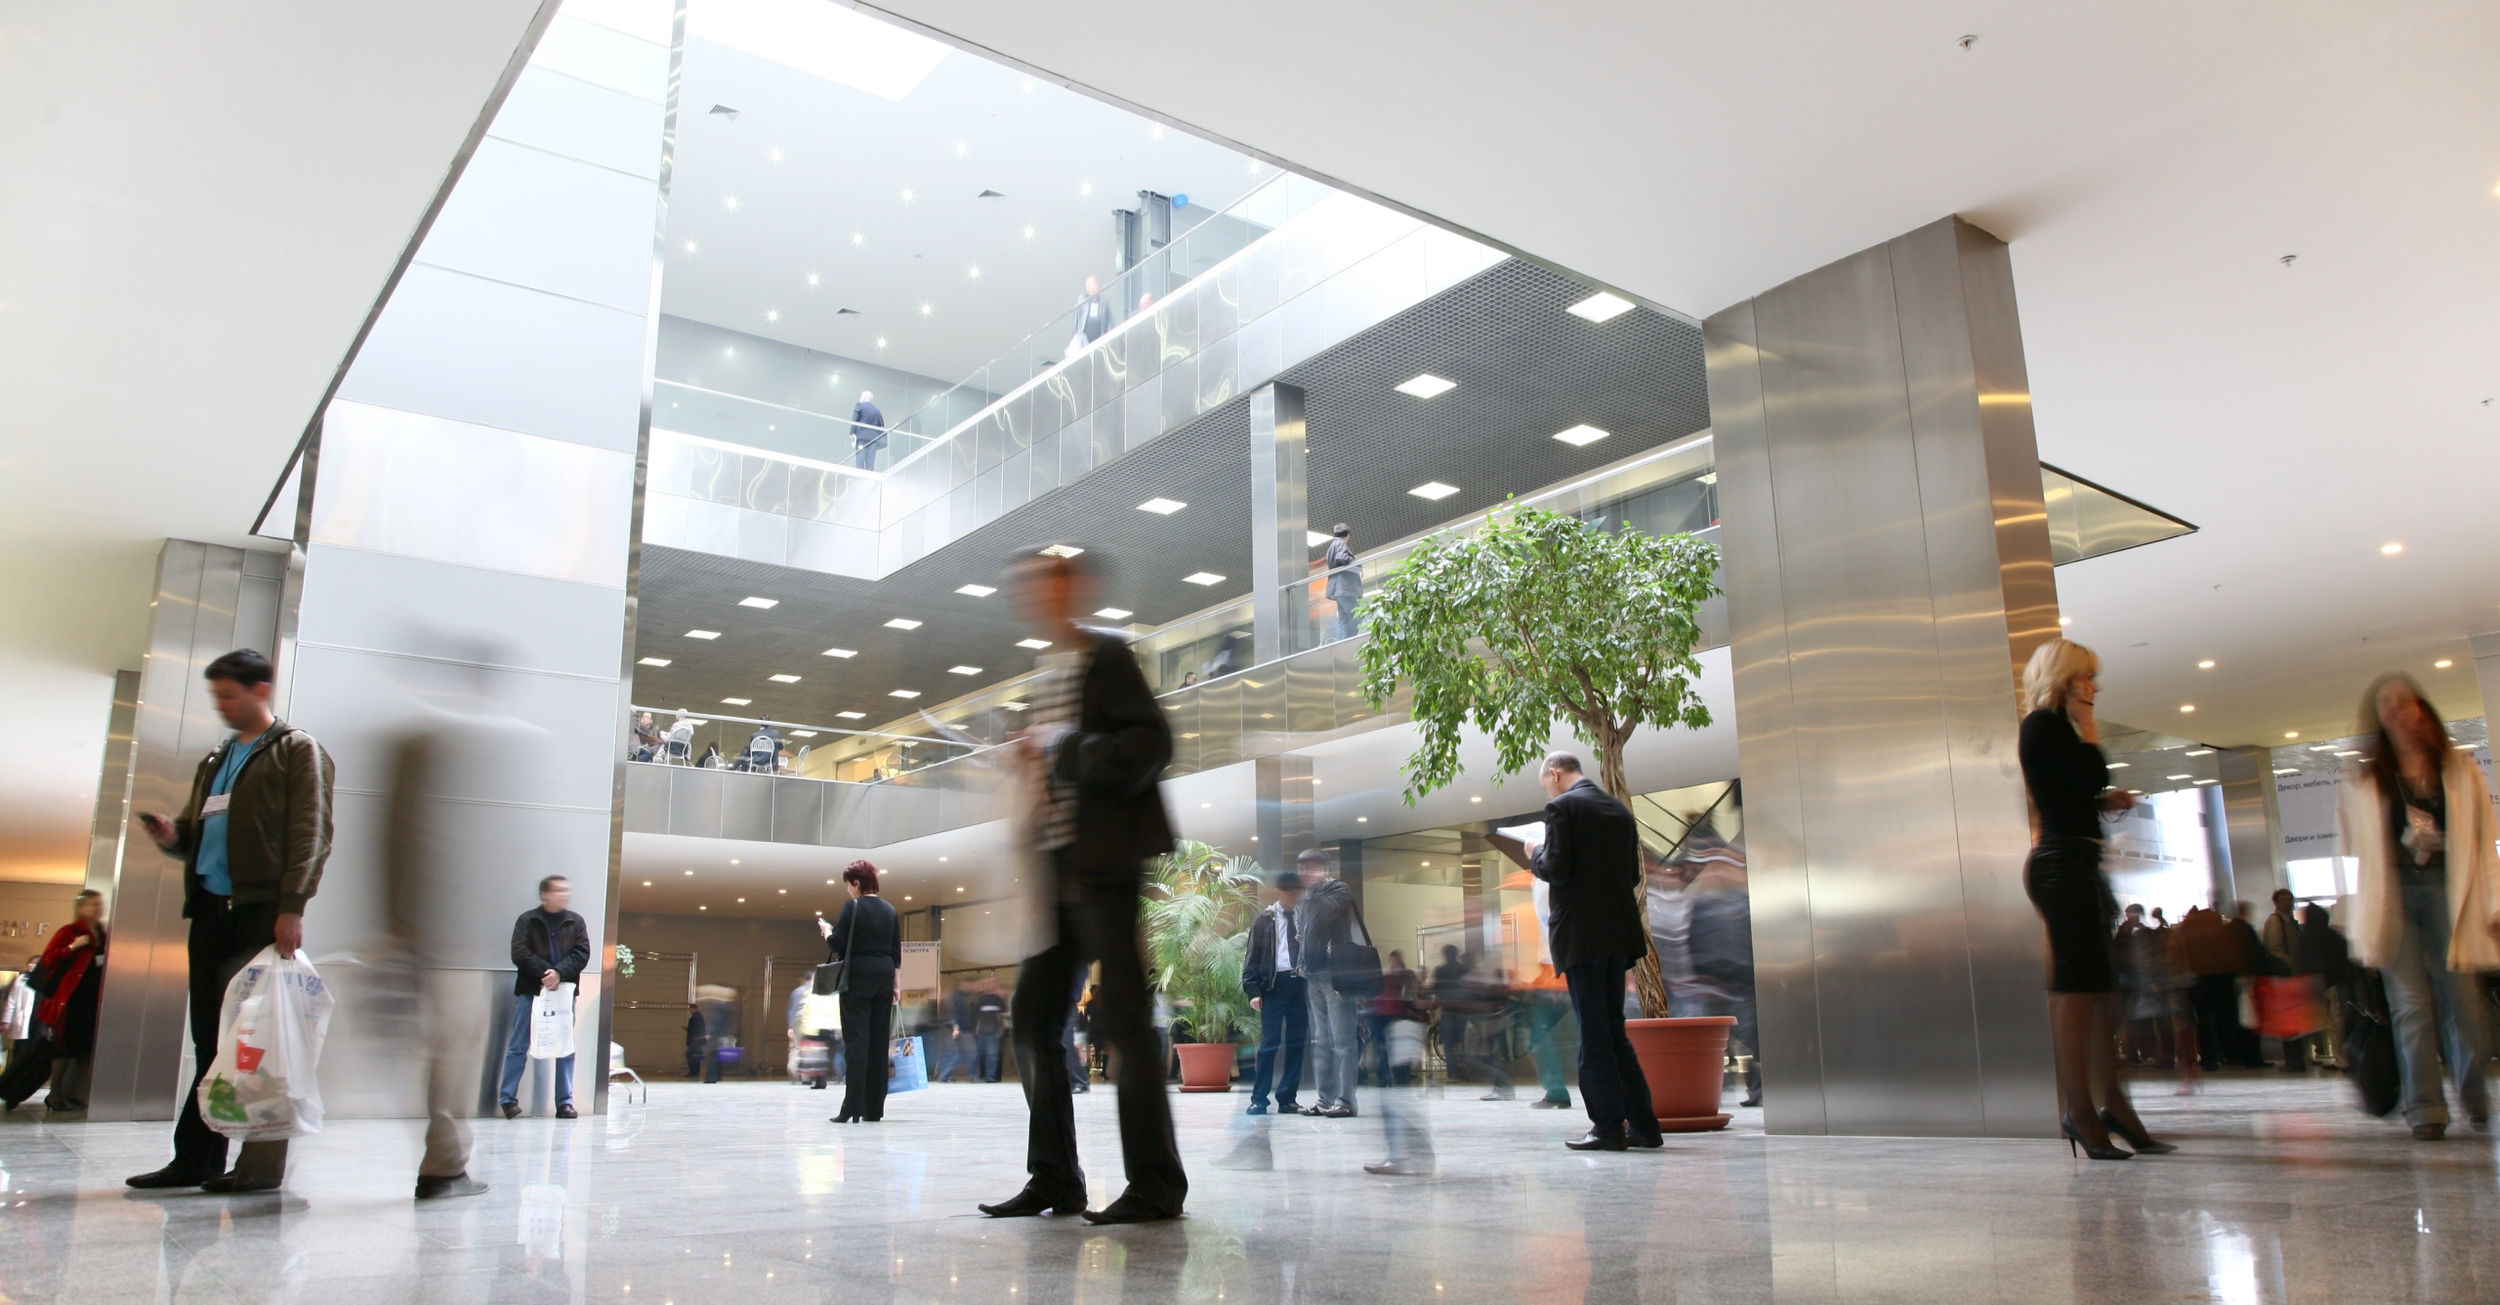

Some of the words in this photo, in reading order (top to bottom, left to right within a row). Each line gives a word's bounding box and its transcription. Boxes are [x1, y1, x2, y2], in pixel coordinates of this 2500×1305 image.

[2277, 784, 2302, 792] Декор,
[2303, 780, 2332, 788] мебель,
[2285, 835, 2308, 844] Двери
